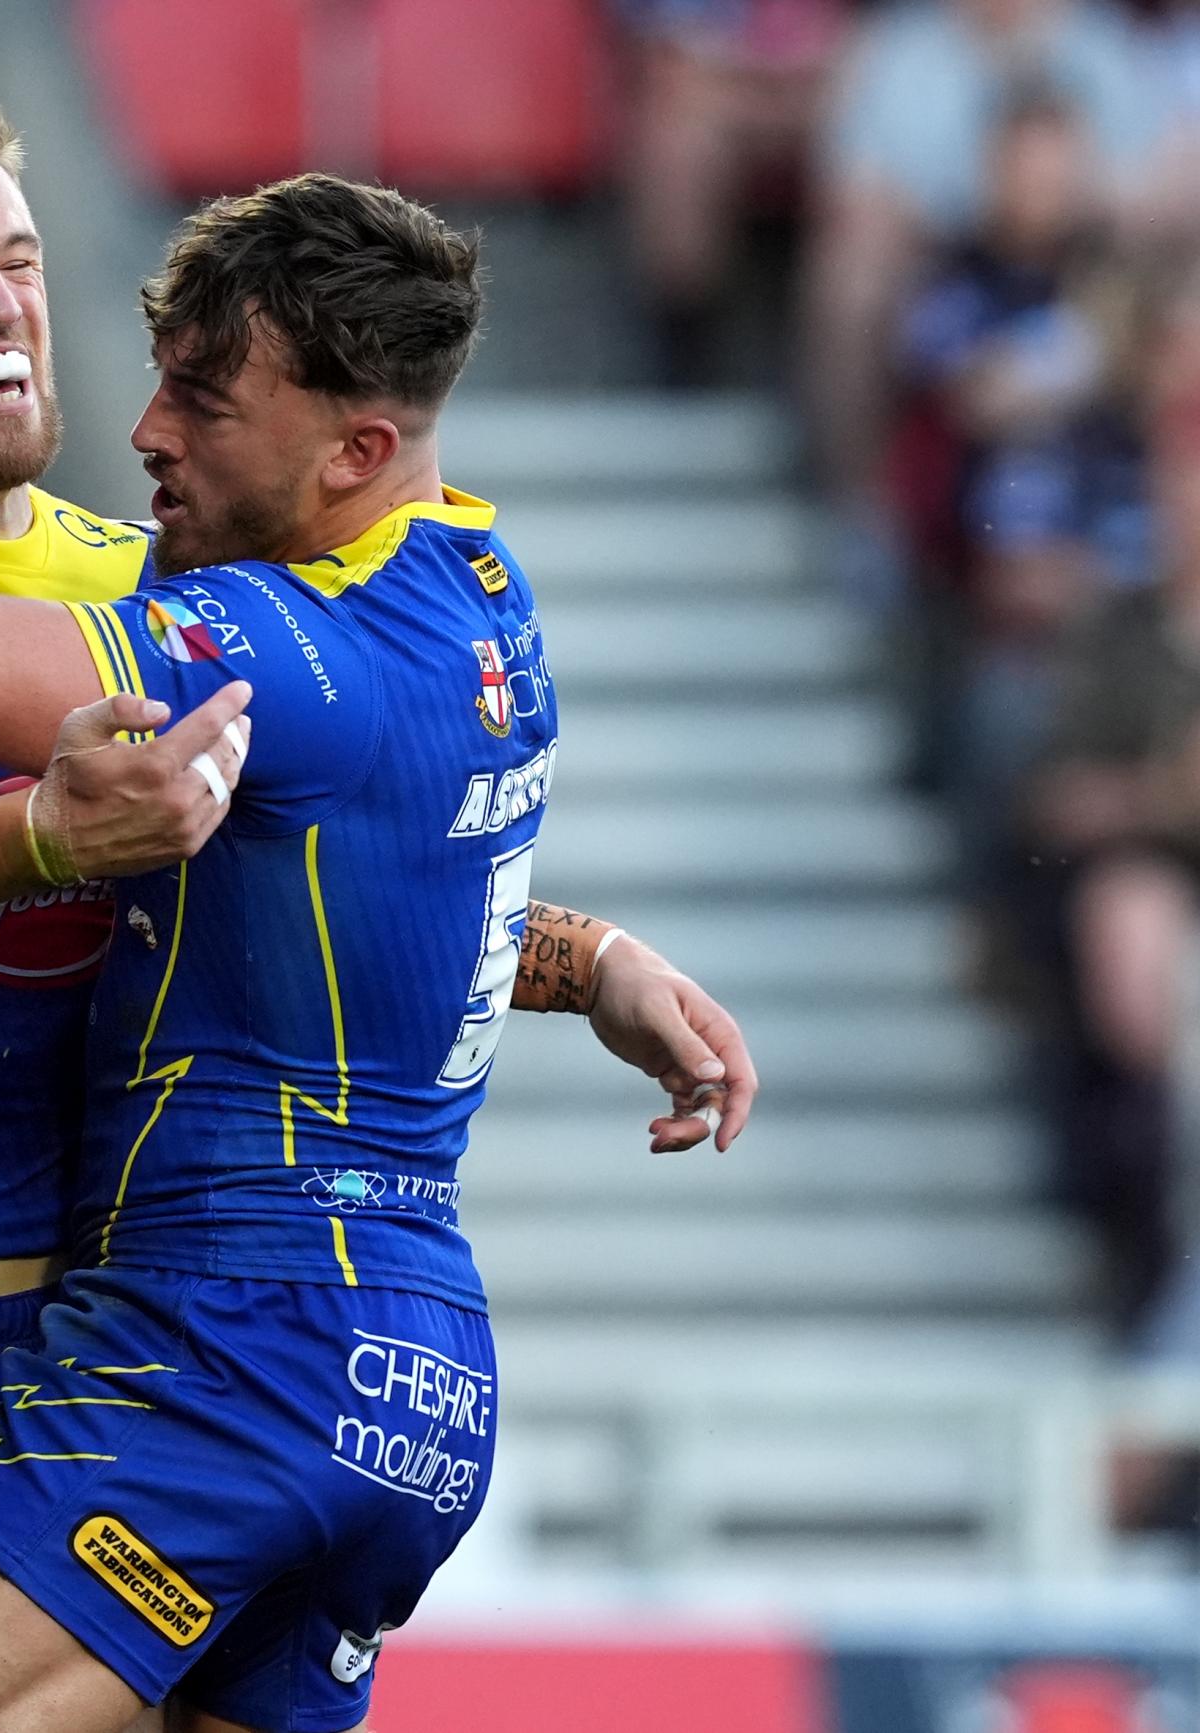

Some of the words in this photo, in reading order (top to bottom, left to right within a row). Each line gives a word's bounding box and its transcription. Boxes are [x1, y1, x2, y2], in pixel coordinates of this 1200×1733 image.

[55, 509, 107, 547] C4
[183, 585, 256, 658] TCAT
[435, 837, 537, 1089] 5
[521, 926, 574, 971] JOB
[347, 1343, 492, 1437] CHESHIRE
[335, 1414, 479, 1514] mouldings
[84, 1538, 193, 1637] FABRICATIONS
[100, 1525, 206, 1623] WARRINGTON
